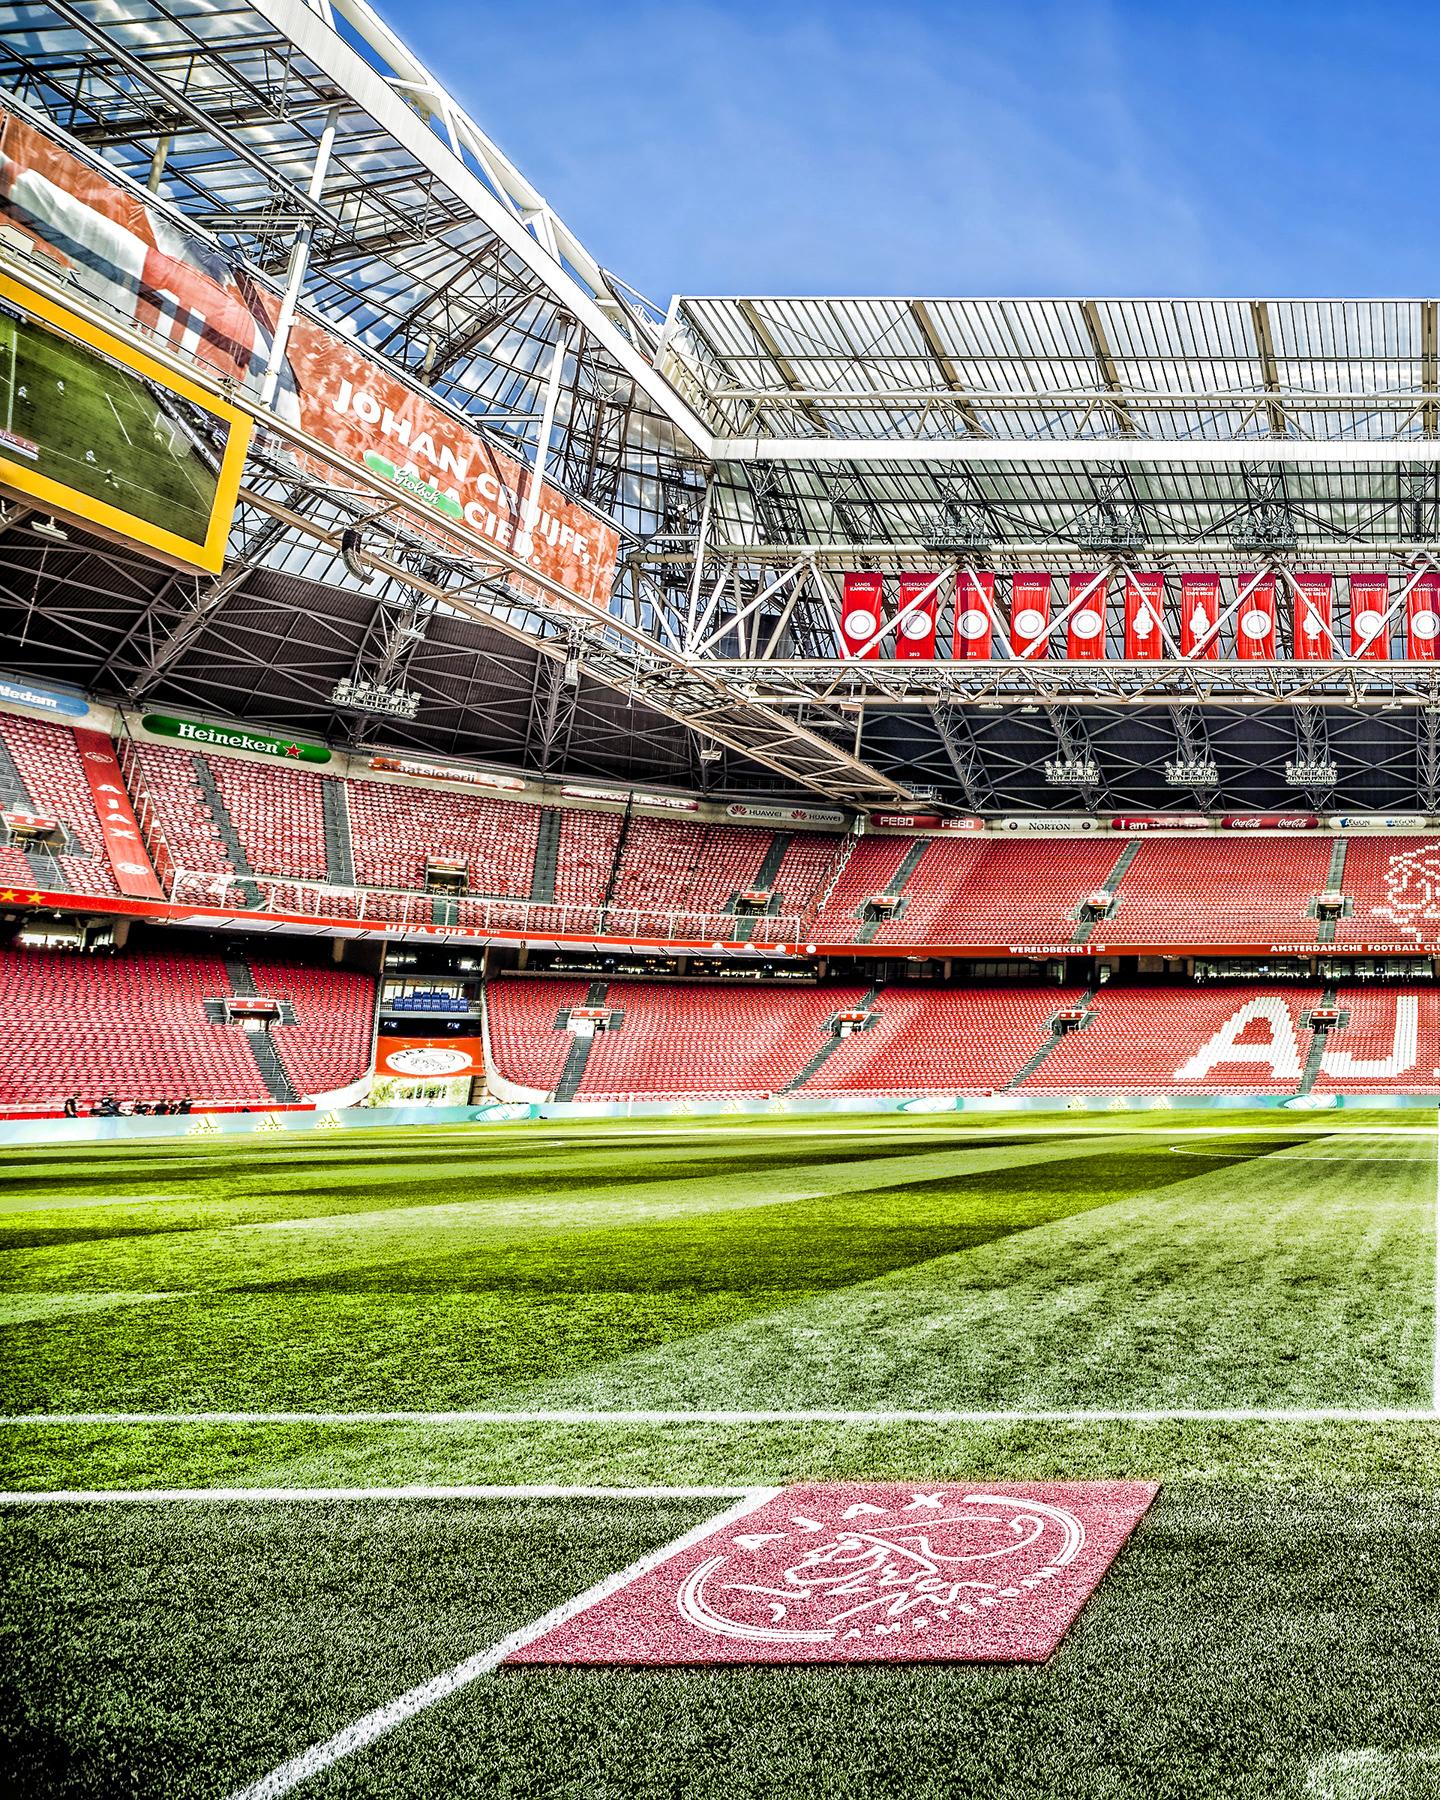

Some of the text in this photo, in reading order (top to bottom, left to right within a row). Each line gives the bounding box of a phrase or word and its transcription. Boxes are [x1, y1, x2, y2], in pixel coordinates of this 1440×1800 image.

[333, 378, 470, 483] JOHAN
[393, 466, 439, 505] Grolsch
[0, 685, 57, 708] Nedam
[178, 723, 279, 755] Heineken
[97, 784, 138, 840] AJAX
[749, 809, 841, 822] HUAWEI HUAWEI
[880, 817, 975, 828] FEBO FEBO
[1028, 822, 1071, 831] NORTON
[1120, 820, 1126, 829] I
[1231, 819, 1307, 828] Coca-Cola Coca-Cola
[385, 924, 467, 936] UEFA CUP
[1270, 944, 1363, 952] AMSTERDAMSCHE
[734, 1491, 946, 1550] AJAX
[842, 1567, 1060, 1640] AMSTERDAM
